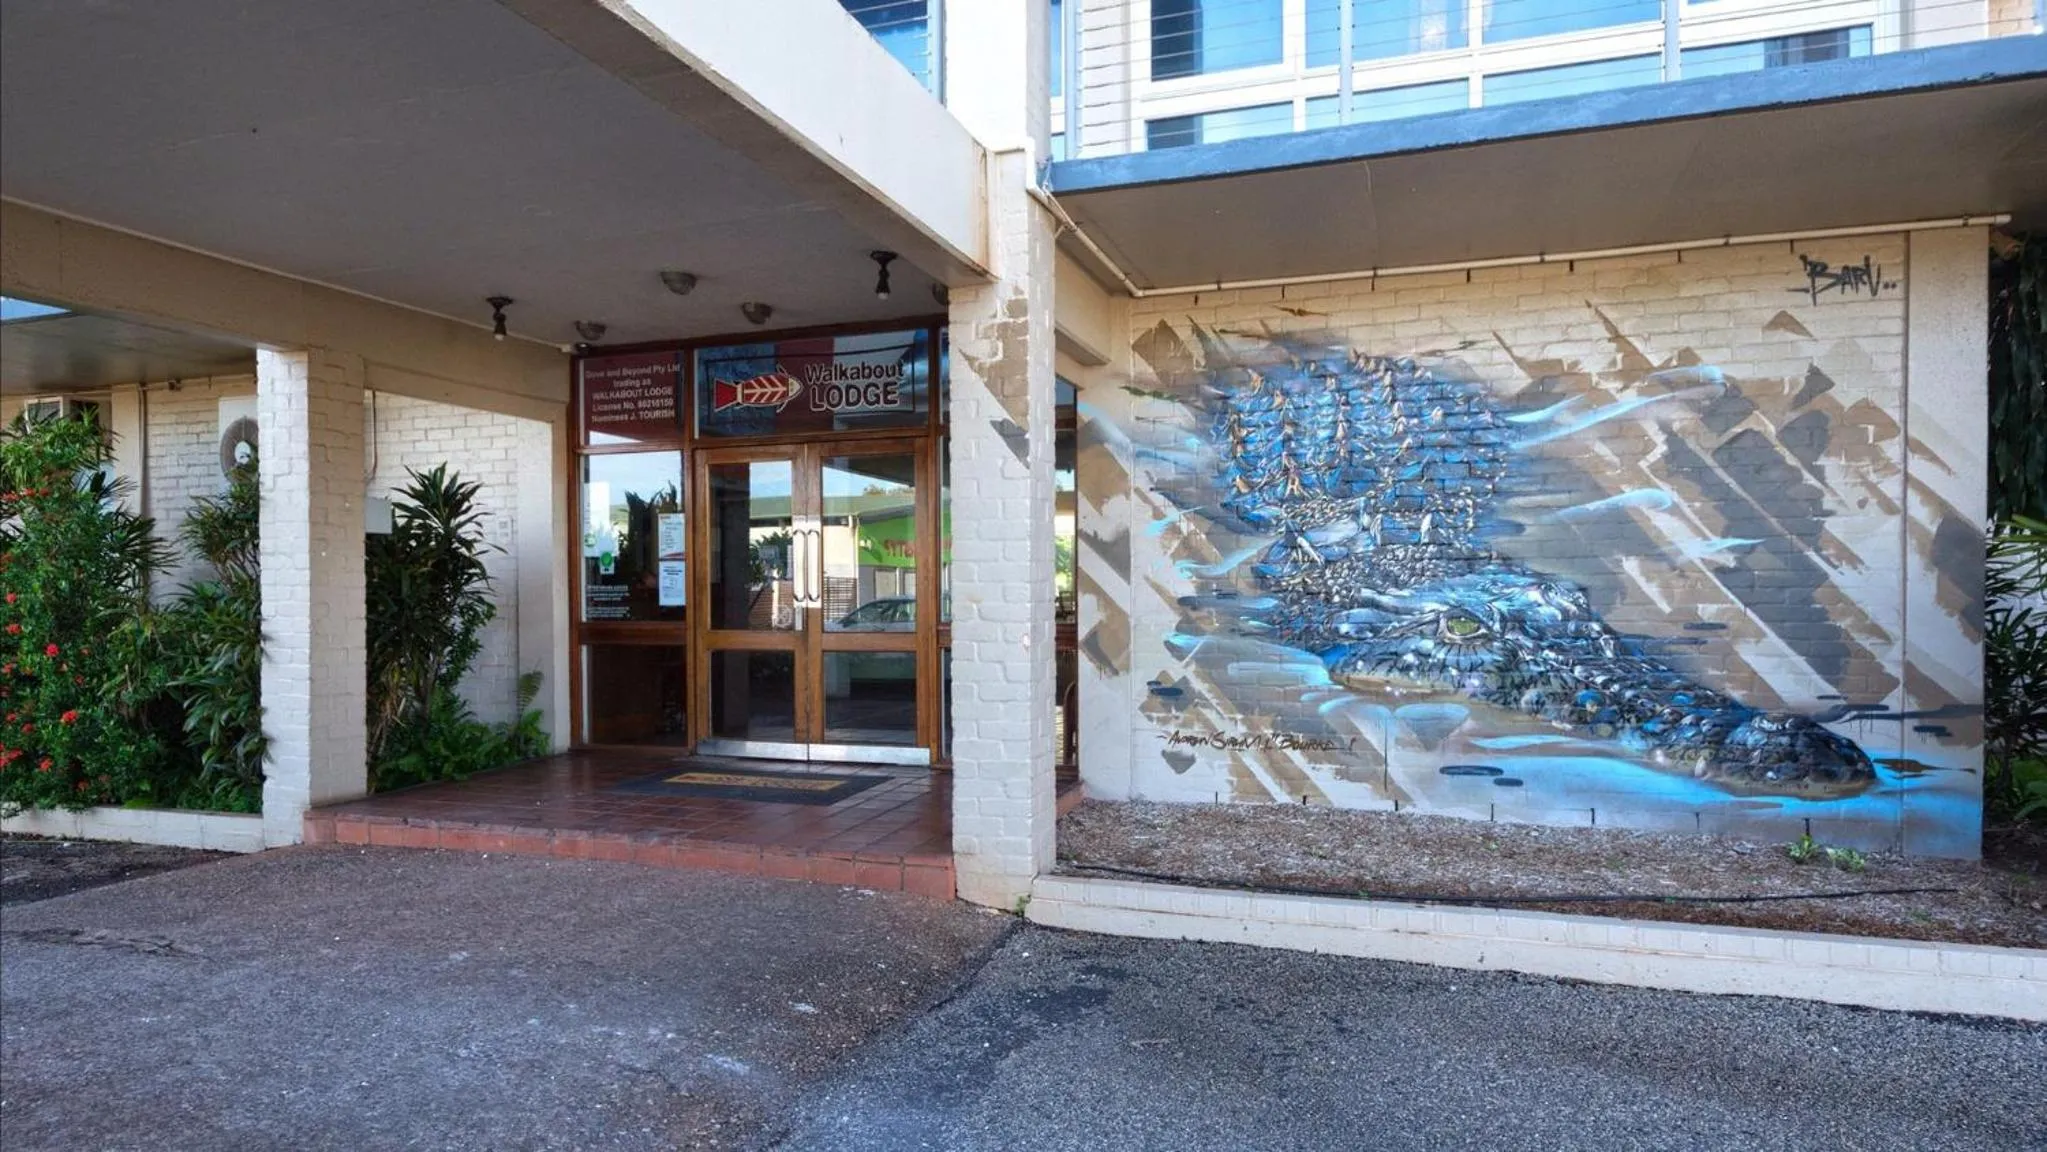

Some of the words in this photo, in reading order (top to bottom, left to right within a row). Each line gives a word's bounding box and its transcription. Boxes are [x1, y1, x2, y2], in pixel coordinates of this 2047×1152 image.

[606, 367, 621, 377] and
[653, 364, 666, 375] Pty
[667, 363, 681, 372] Ltd
[805, 360, 904, 384] Walkabout
[642, 378, 652, 386] as
[592, 388, 642, 400] WALKABOUT
[644, 386, 673, 397] LODGE
[811, 381, 899, 411] LODGE
